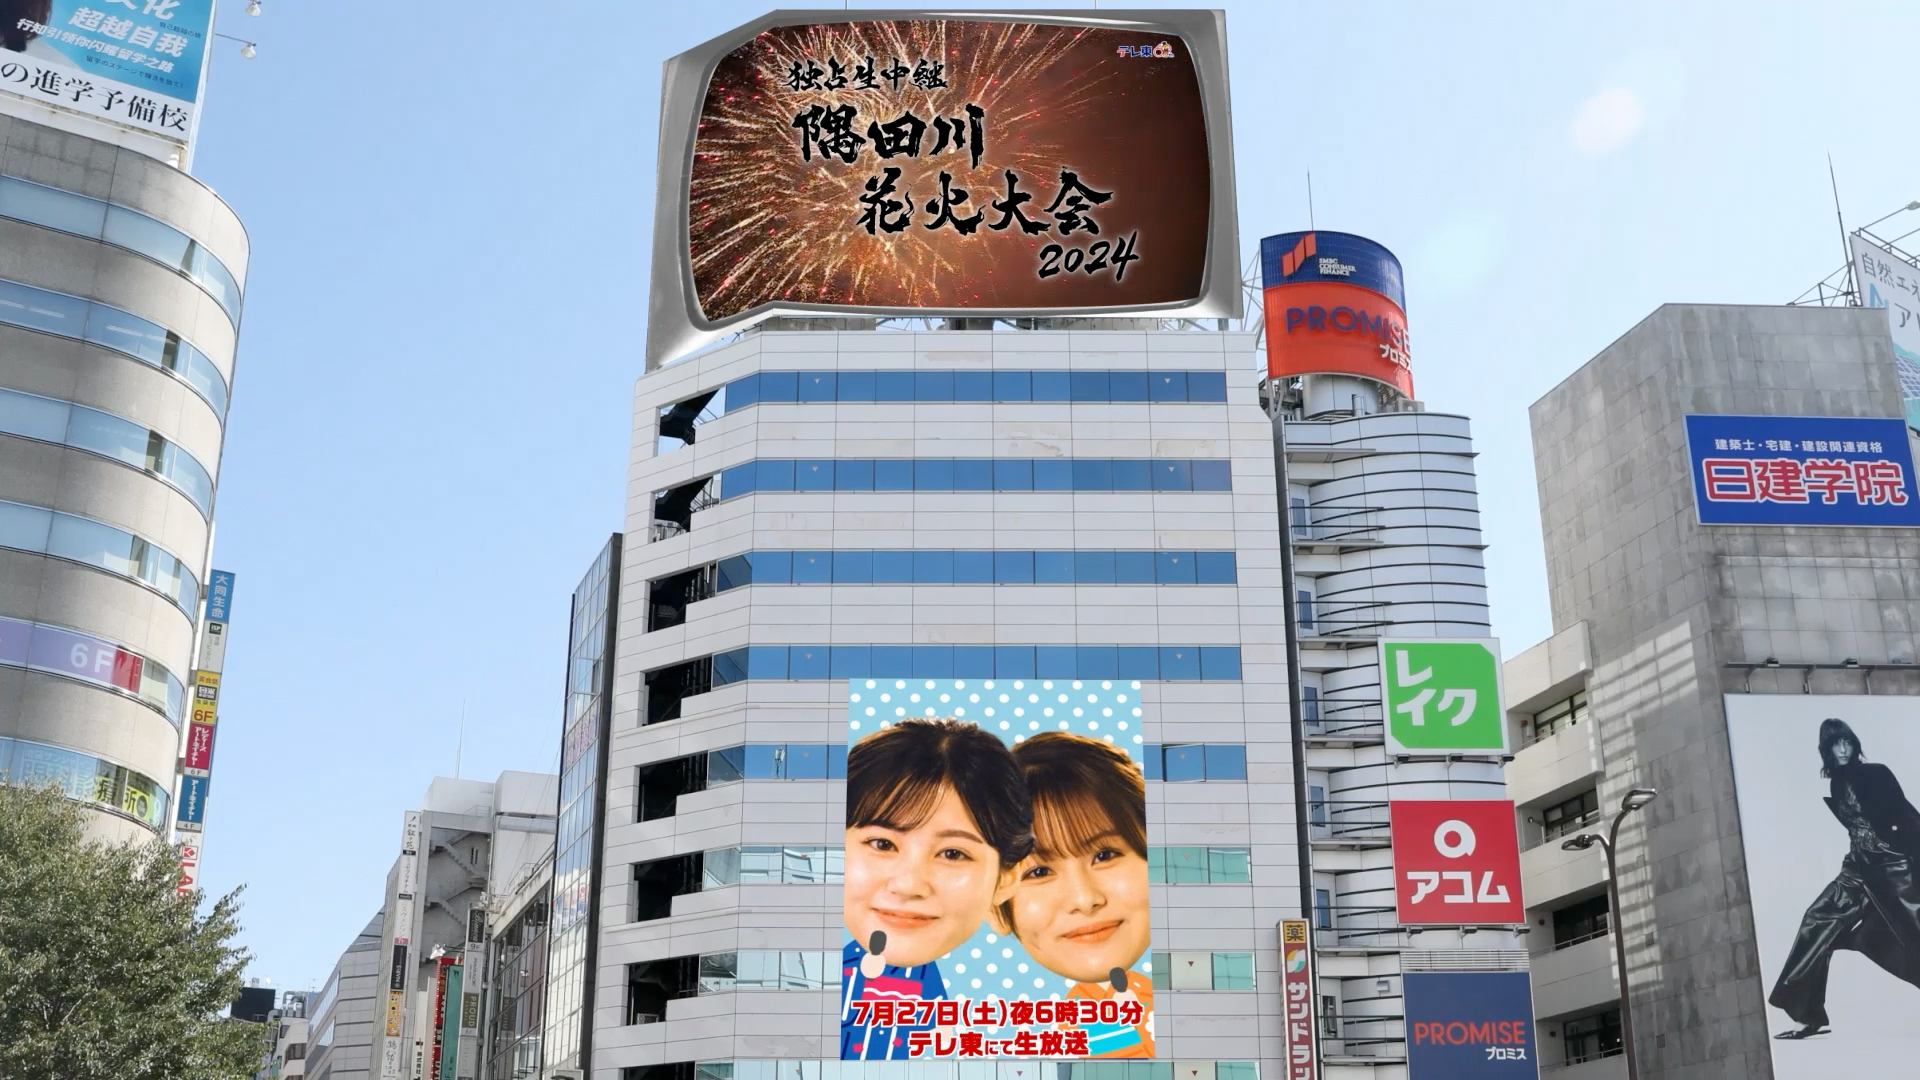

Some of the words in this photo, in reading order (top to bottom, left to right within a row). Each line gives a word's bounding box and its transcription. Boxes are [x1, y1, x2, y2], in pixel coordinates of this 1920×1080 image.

[68, 7, 188, 57] 超越自我
[1117, 46, 1153, 58] テレ東
[781, 56, 948, 91] 独占生中継
[1, 62, 188, 132] の進学予備校
[793, 103, 985, 170] 隅田川
[856, 165, 1114, 235] 花火大会
[1038, 231, 1140, 281] 2024
[1319, 263, 1356, 273] CONSUMER
[1320, 268, 1350, 276] FINANCE
[1286, 305, 1410, 357] PROMISE
[1715, 438, 1883, 453] 建築士・宅建・建設関連資格
[1702, 458, 1909, 506] 日建学院
[211, 574, 229, 618] 大同生命
[70, 642, 114, 673] 6F
[194, 709, 214, 722] 6F
[1407, 871, 1511, 904] アコム
[1286, 924, 1304, 942] 薬
[468, 995, 477, 1028] PROUD
[850, 1000, 1145, 1027] 7月27日(土)夜6時30分
[908, 1030, 1090, 1057] テレ東にて生放送
[1414, 1022, 1526, 1046] PROMISE
[1485, 1046, 1527, 1061] プロミス
